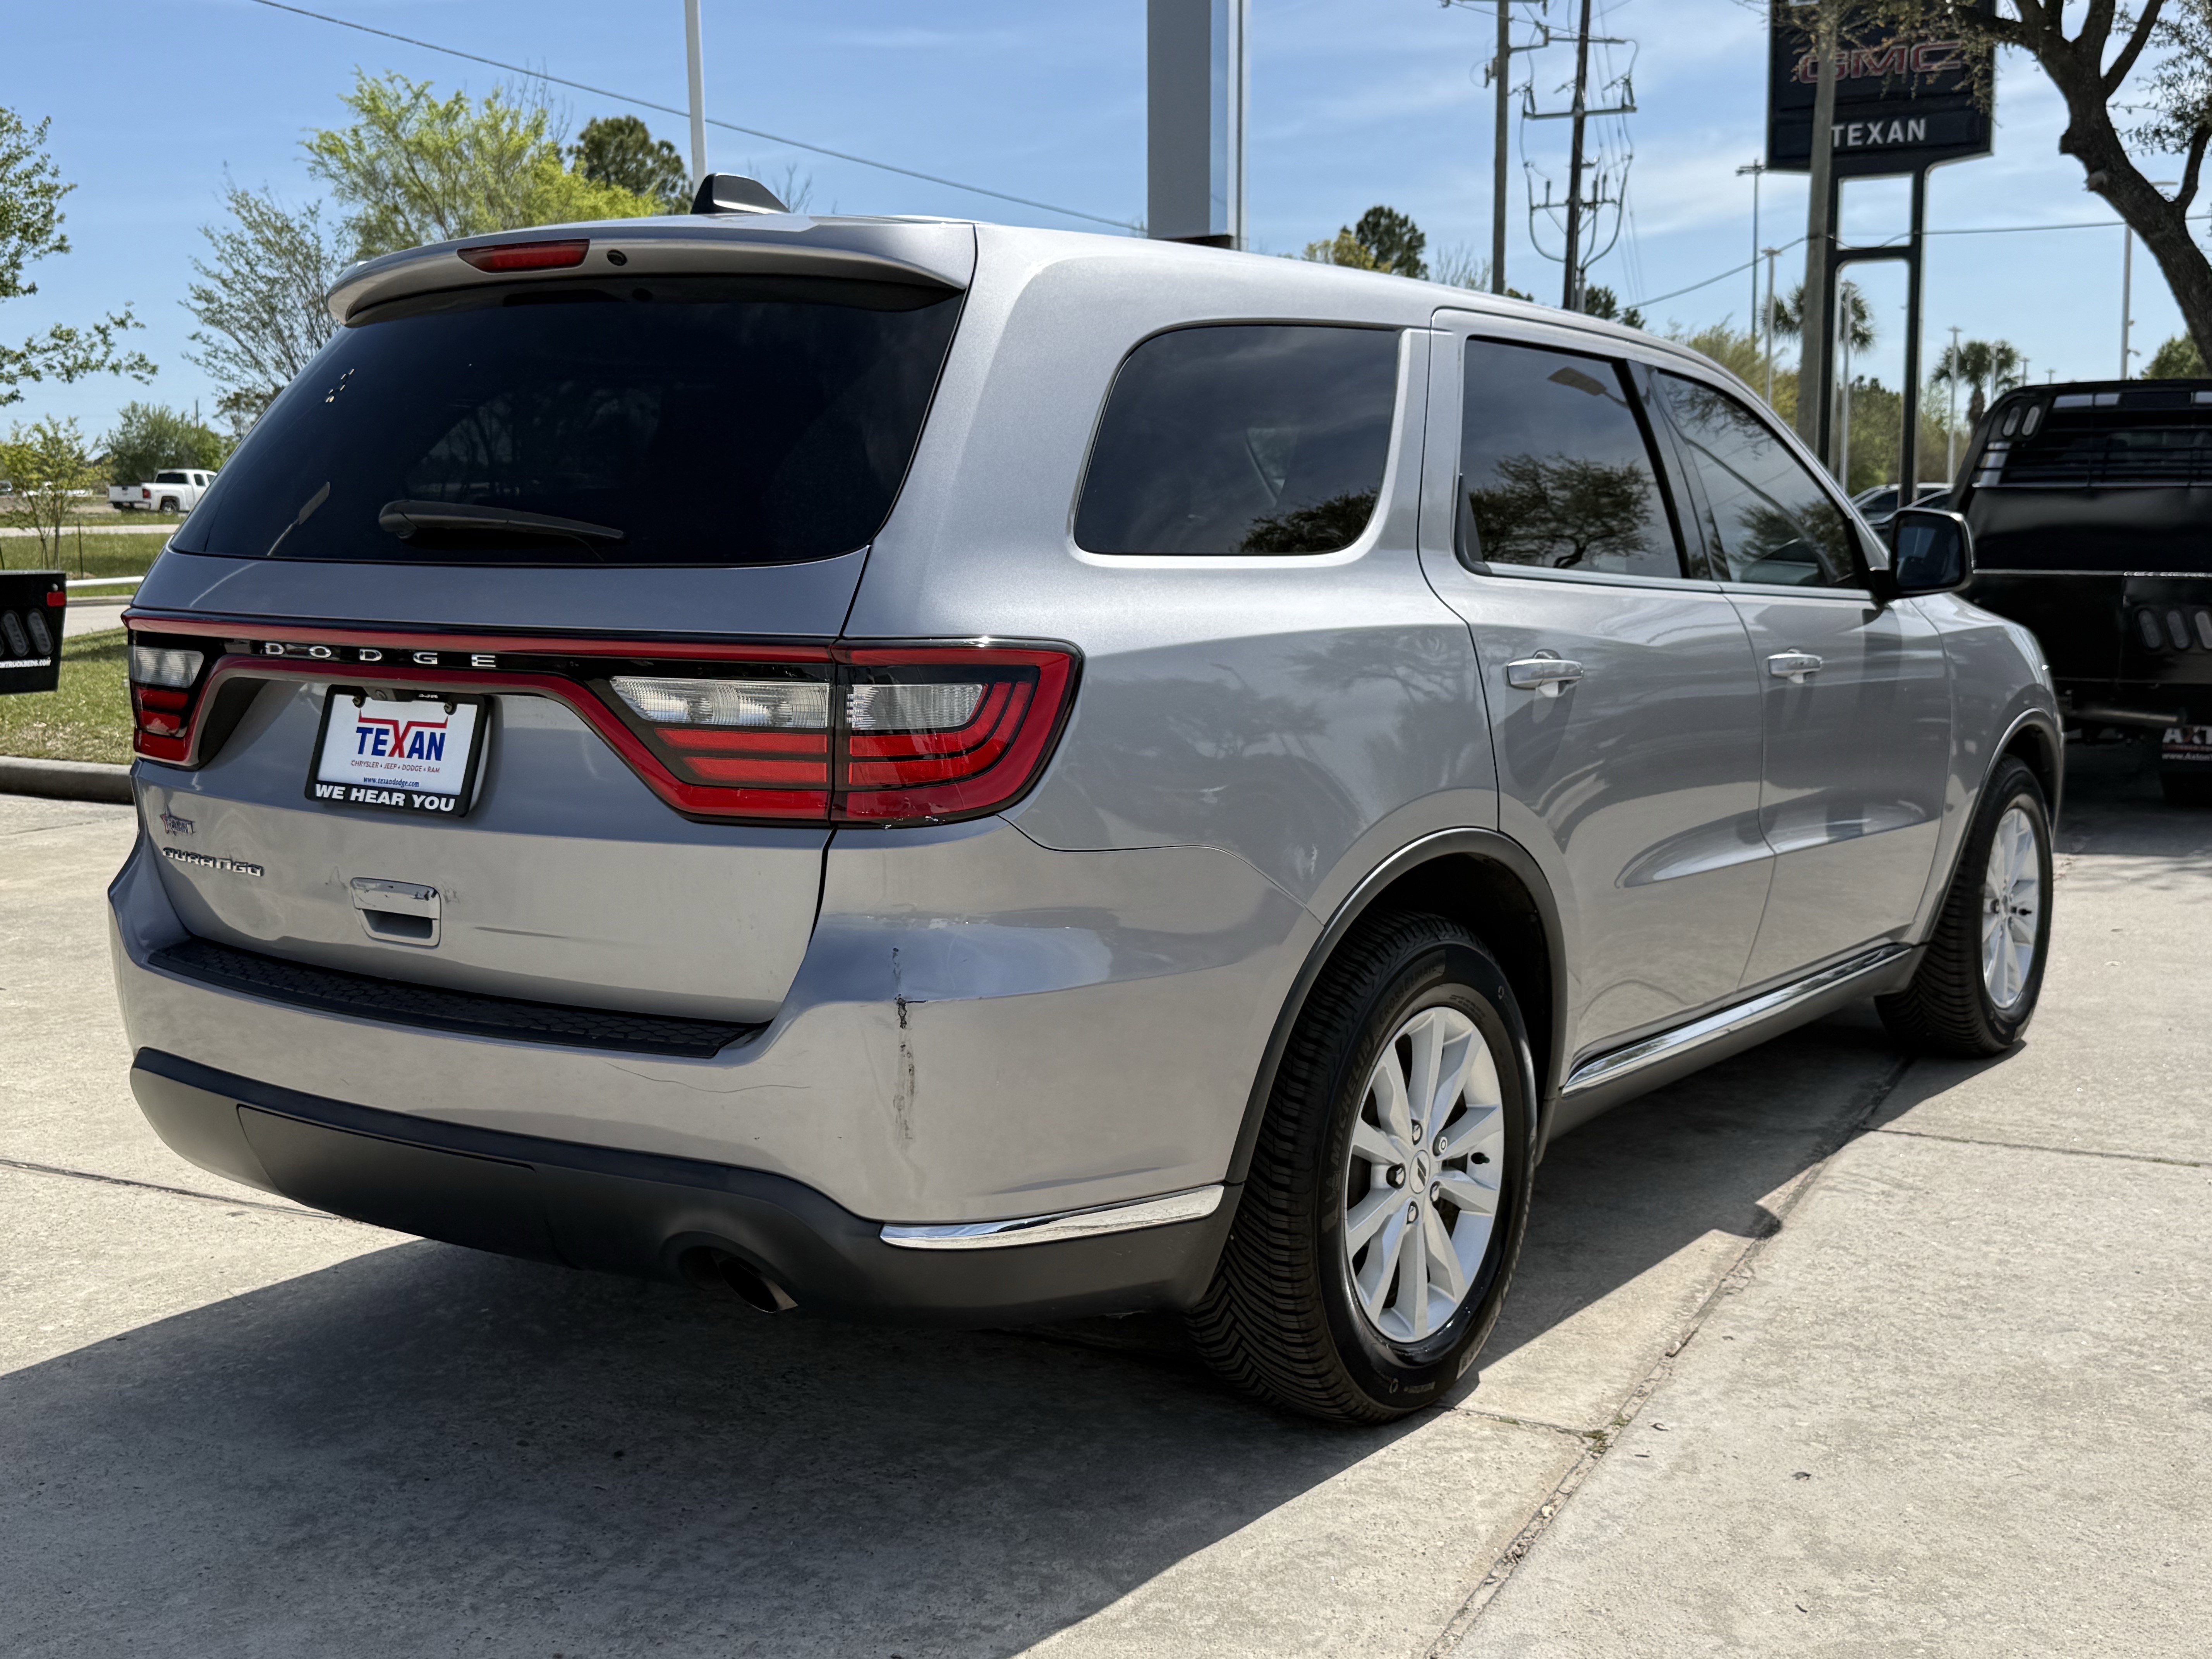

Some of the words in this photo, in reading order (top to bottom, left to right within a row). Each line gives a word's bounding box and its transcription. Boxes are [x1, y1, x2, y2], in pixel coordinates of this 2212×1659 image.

[1798, 41, 1961, 84] GMC
[1831, 118, 1926, 147] TEXAN
[265, 642, 496, 668] DODGE
[356, 713, 448, 761] TEXAN
[351, 760, 379, 768] CHRYSLER
[402, 764, 422, 772] DODGE
[363, 777, 420, 788] www.texandodge.com
[315, 783, 346, 800] WE
[350, 787, 406, 806] HEAR
[412, 795, 455, 812] YOU
[163, 847, 264, 877] DURANGO
[1330, 1034, 1374, 1167] MICHELIN
